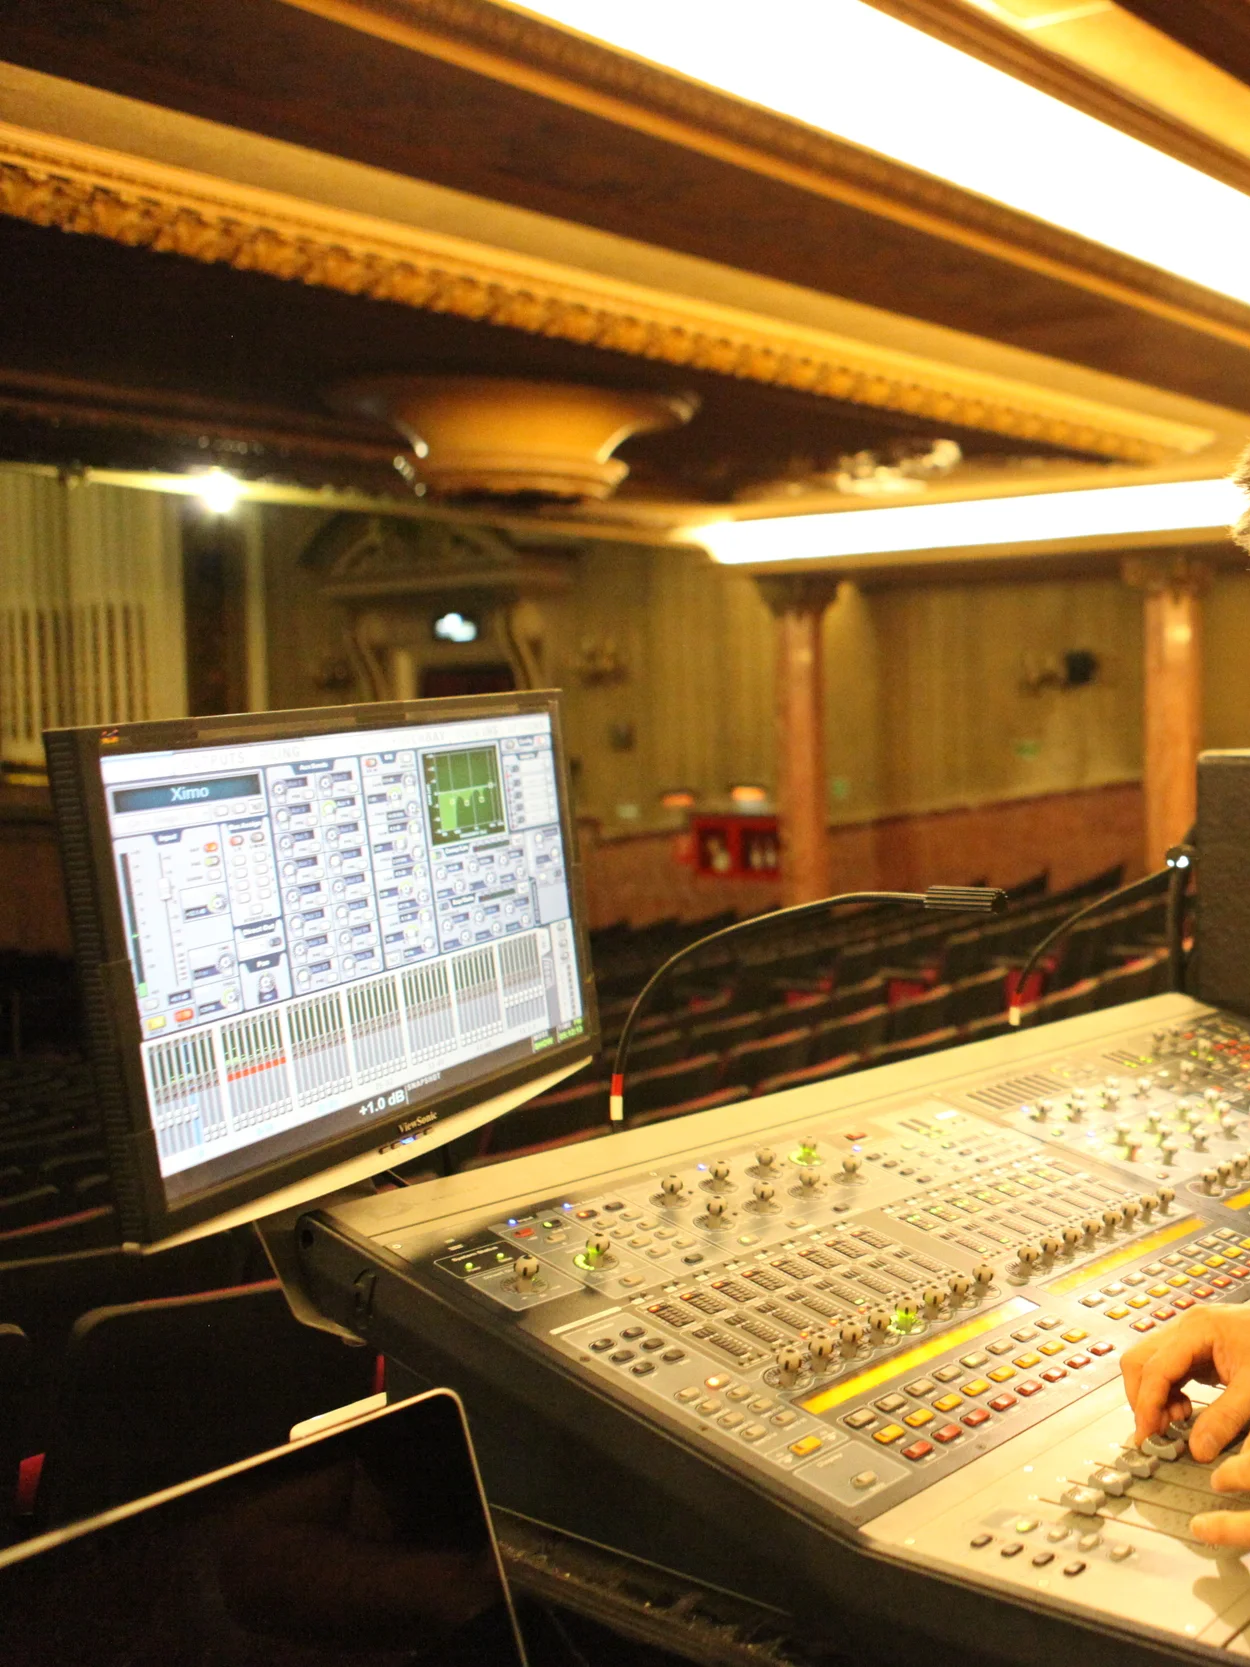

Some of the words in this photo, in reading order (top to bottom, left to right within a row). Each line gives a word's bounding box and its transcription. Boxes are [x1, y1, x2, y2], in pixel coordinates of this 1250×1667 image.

[169, 786, 210, 802] Ximo
[359, 1097, 386, 1115] +1.0
[388, 1089, 406, 1106] dB
[398, 1111, 438, 1133] ViewSonic
